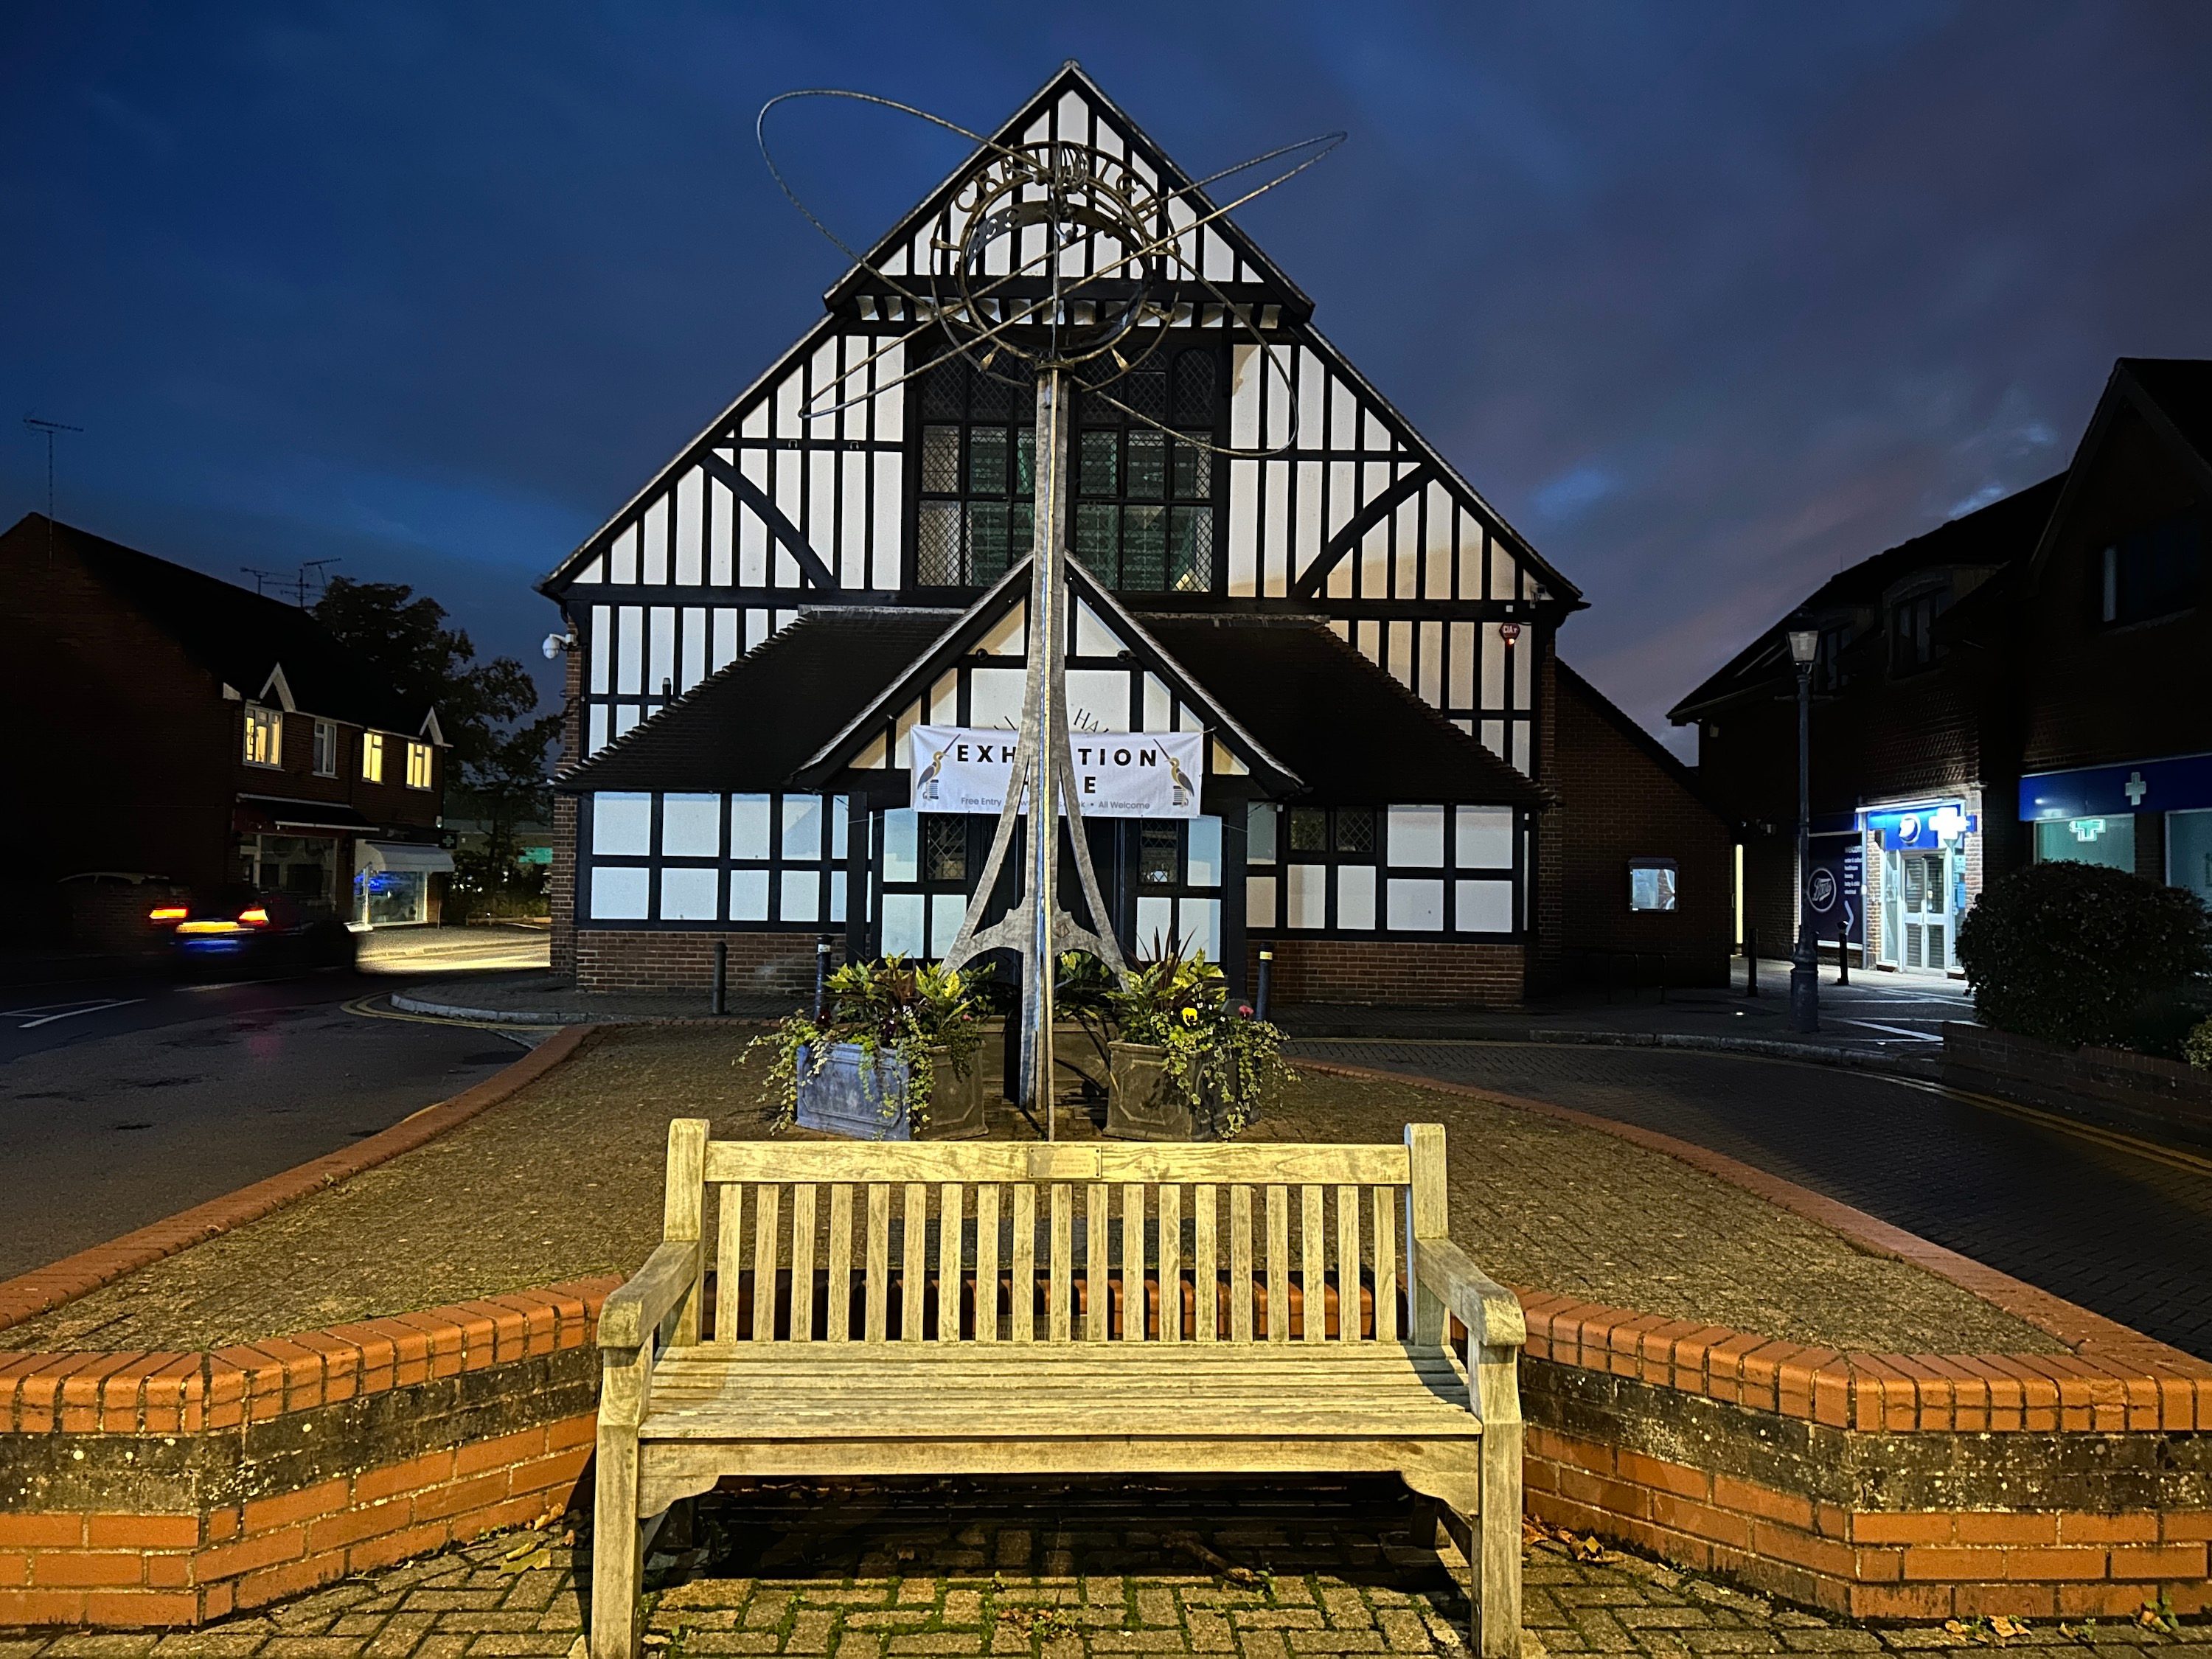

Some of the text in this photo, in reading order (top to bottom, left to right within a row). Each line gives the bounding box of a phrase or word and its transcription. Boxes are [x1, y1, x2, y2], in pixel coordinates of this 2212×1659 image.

[955, 147, 1161, 222] CRANIGH
[1074, 708, 1109, 733] HA
[957, 745, 1156, 767] EXHTION
[961, 797, 1150, 809] Free Entry All Welcome
